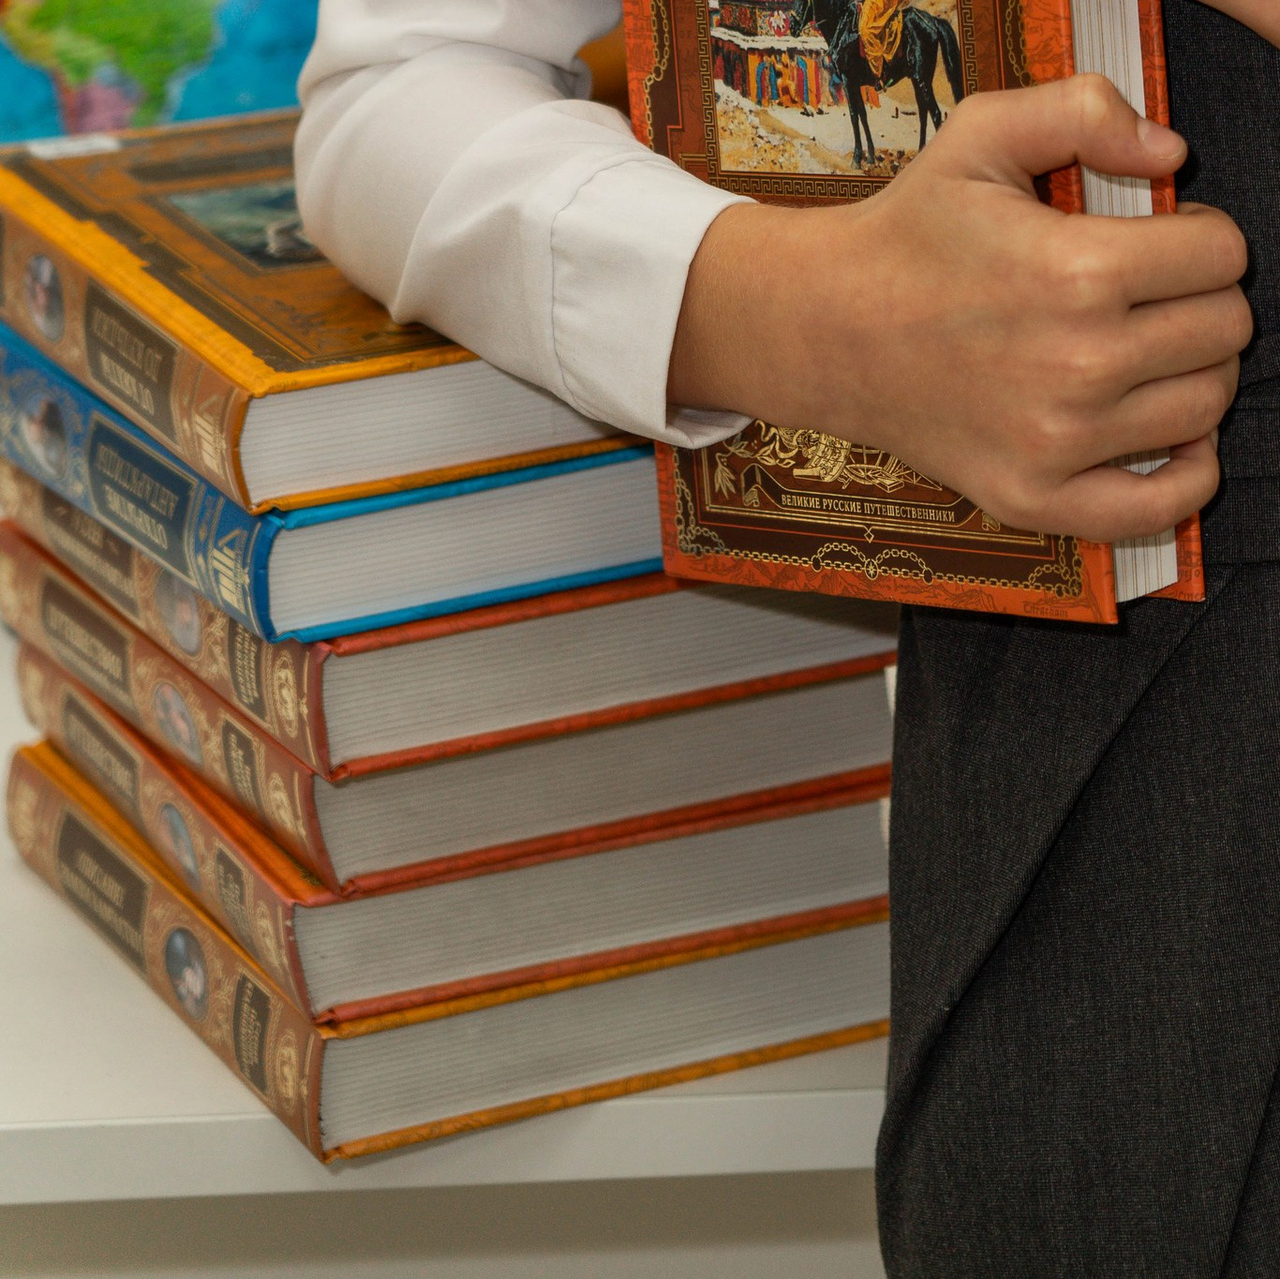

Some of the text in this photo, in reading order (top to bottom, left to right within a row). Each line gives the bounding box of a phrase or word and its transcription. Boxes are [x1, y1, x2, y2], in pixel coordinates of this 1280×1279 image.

[781, 494, 956, 523] ВЕЛИКИЕ РУССКИЕ ПУТЕШЕСТВЕННИКИ
